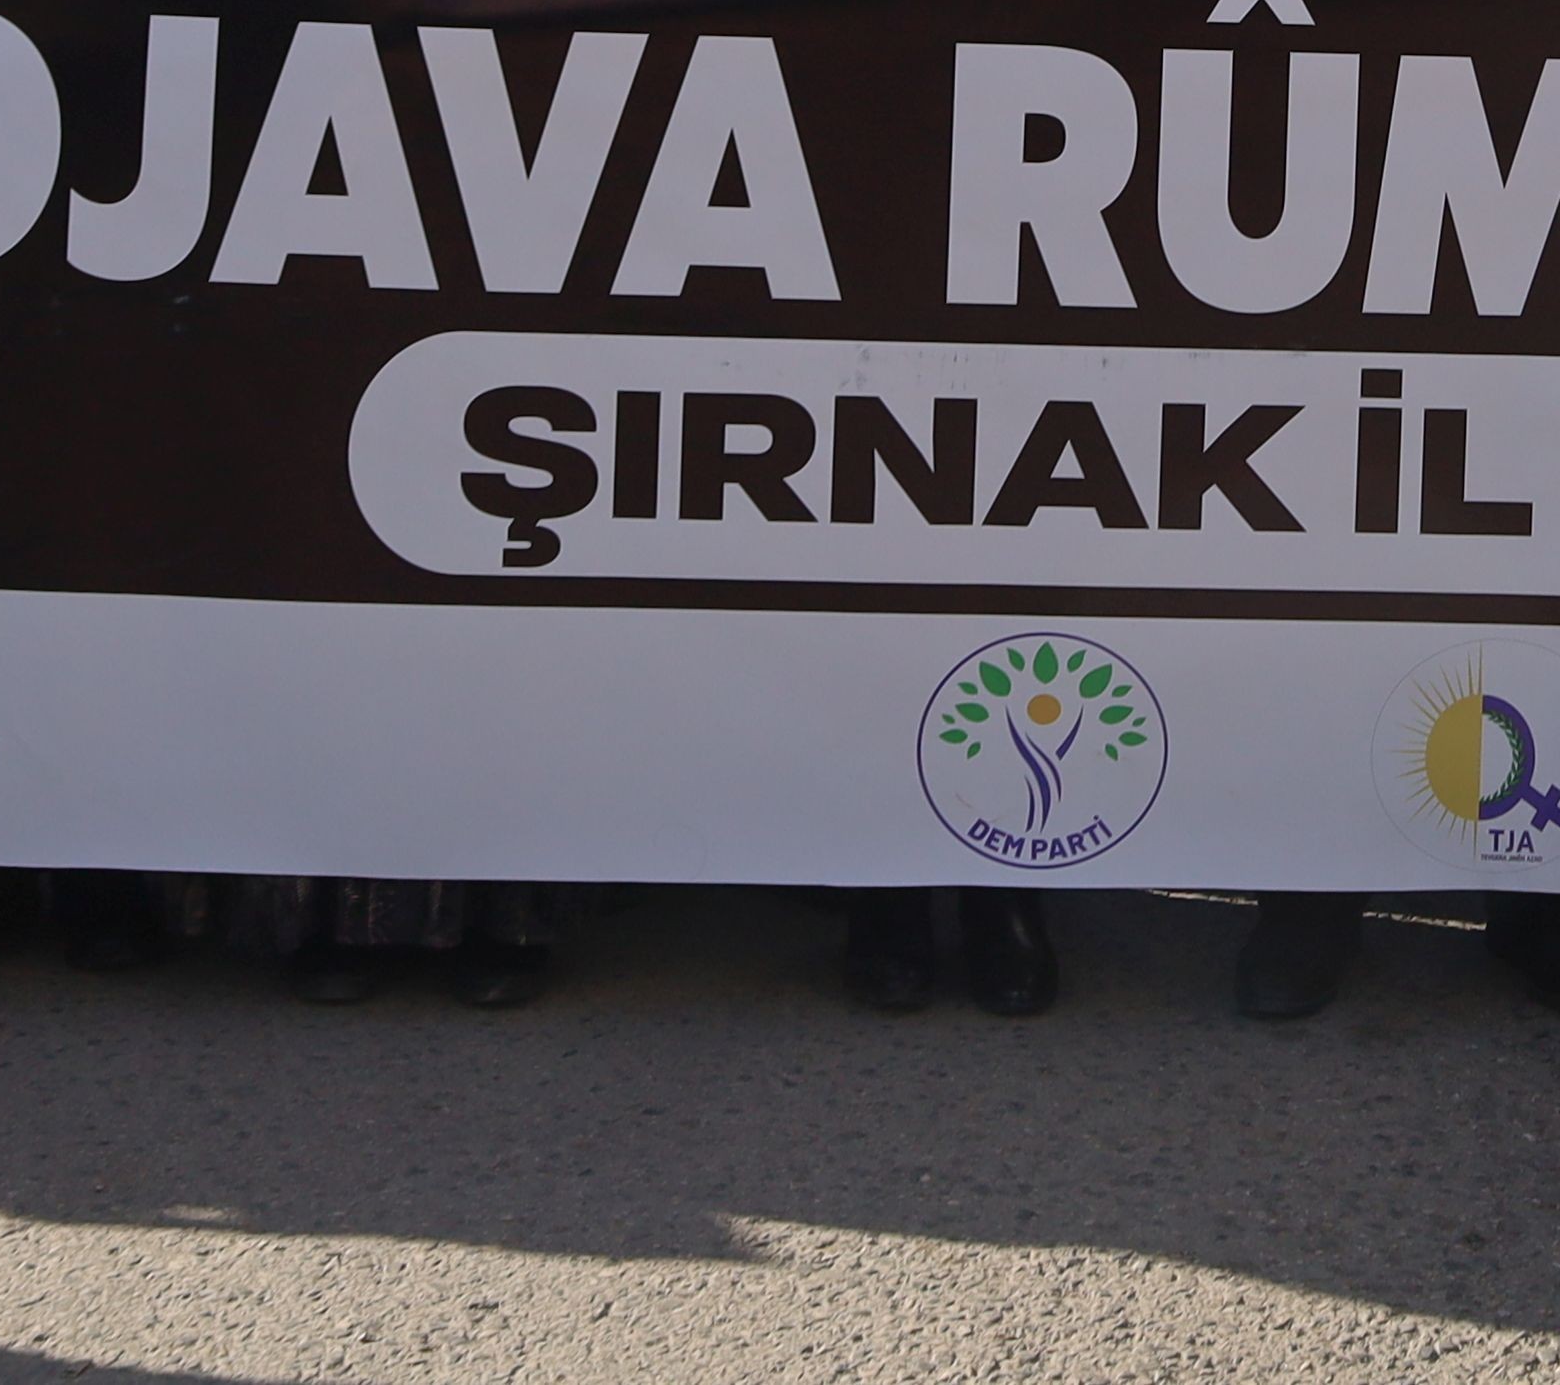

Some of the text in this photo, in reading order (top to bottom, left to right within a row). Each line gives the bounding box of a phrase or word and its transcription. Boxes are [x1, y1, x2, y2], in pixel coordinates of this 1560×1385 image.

[460, 385, 1307, 568] ŞIRNAK
[1354, 368, 1534, 537] İL
[966, 814, 1113, 861] DEM PARTİ
[1488, 828, 1535, 853] TJA
